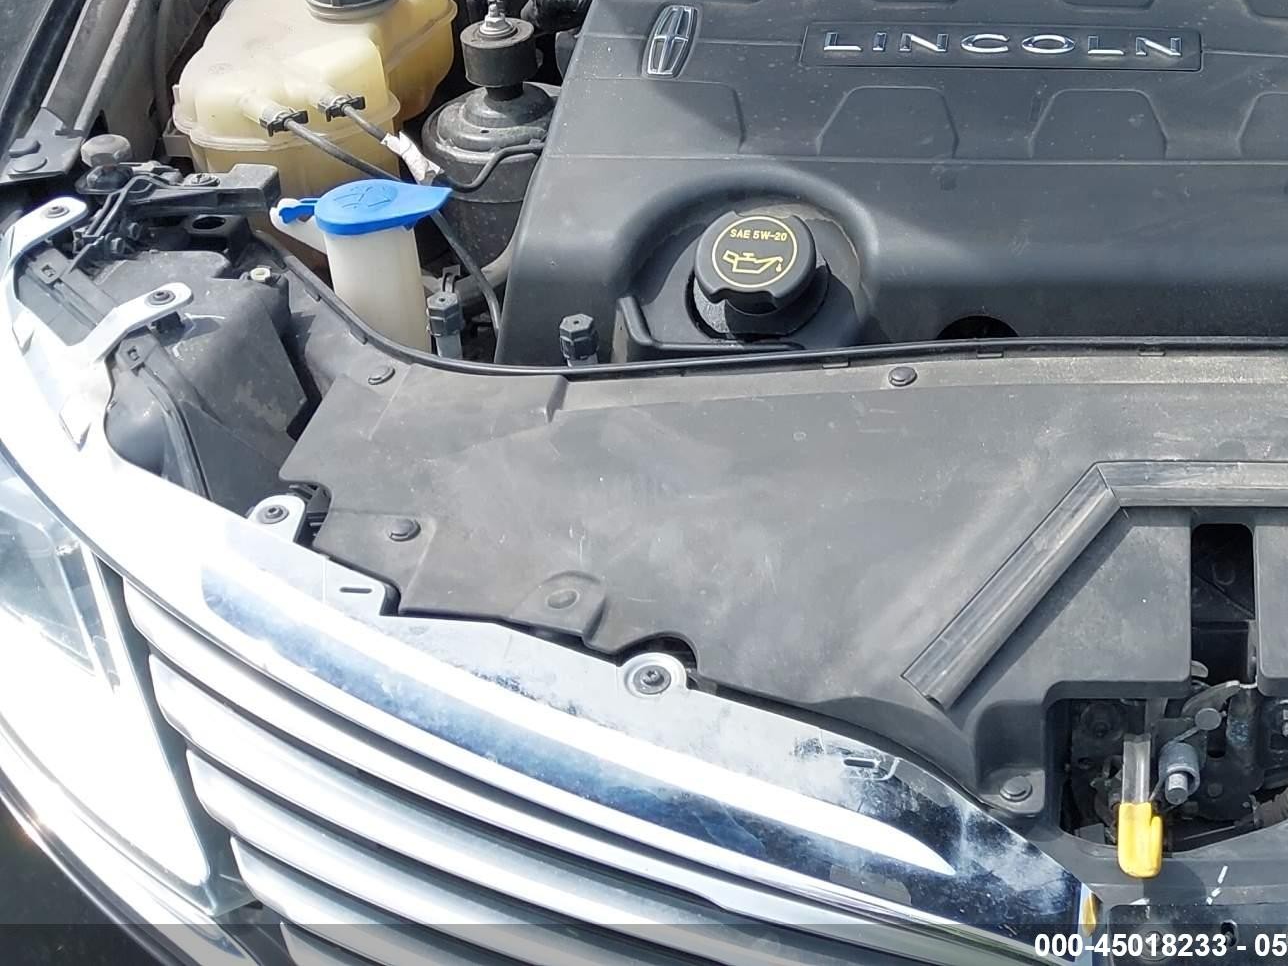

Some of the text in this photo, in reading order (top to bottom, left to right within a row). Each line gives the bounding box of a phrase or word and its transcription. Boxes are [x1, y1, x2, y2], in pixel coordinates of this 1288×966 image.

[823, 31, 1183, 57] LINCOLN
[730, 229, 787, 241] SAE 5W-20
